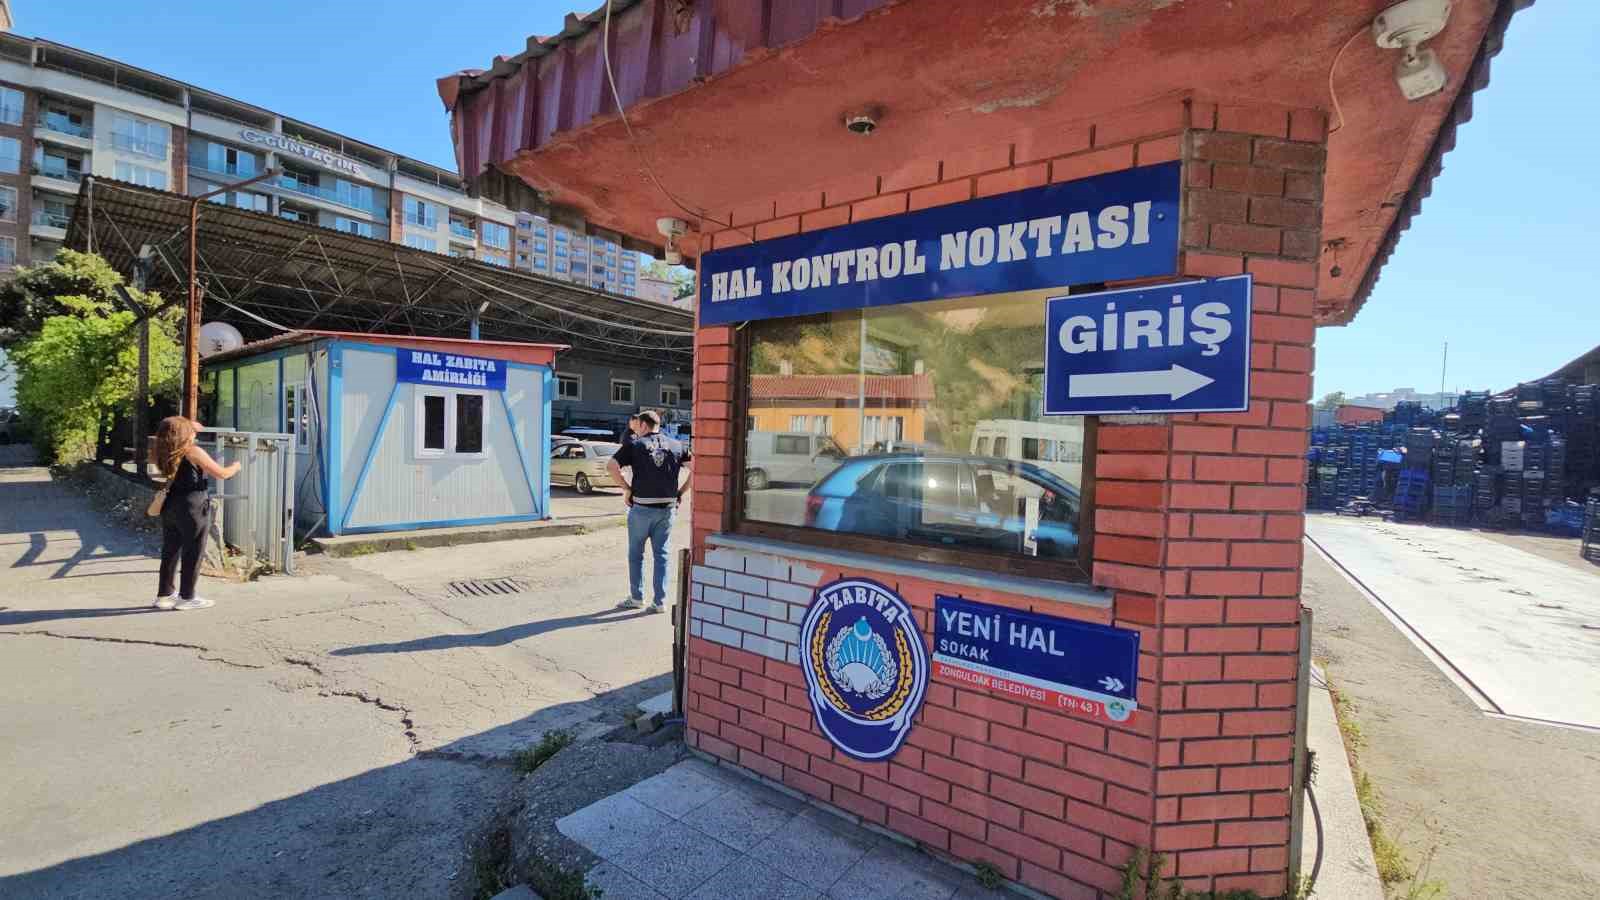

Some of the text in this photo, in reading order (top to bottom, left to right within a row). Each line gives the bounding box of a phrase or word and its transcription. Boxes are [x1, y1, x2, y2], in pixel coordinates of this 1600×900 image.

[711, 200, 1153, 303] HAL KONTROL NOKTASI
[1058, 294, 1233, 357] GİRİŞ
[411, 351, 497, 372] HAL ZABITA
[421, 368, 488, 386] AMİRLİĞİ
[828, 586, 899, 624] ZABITA
[940, 638, 990, 662] SOKAK
[941, 607, 1065, 657] YENİ HAL
